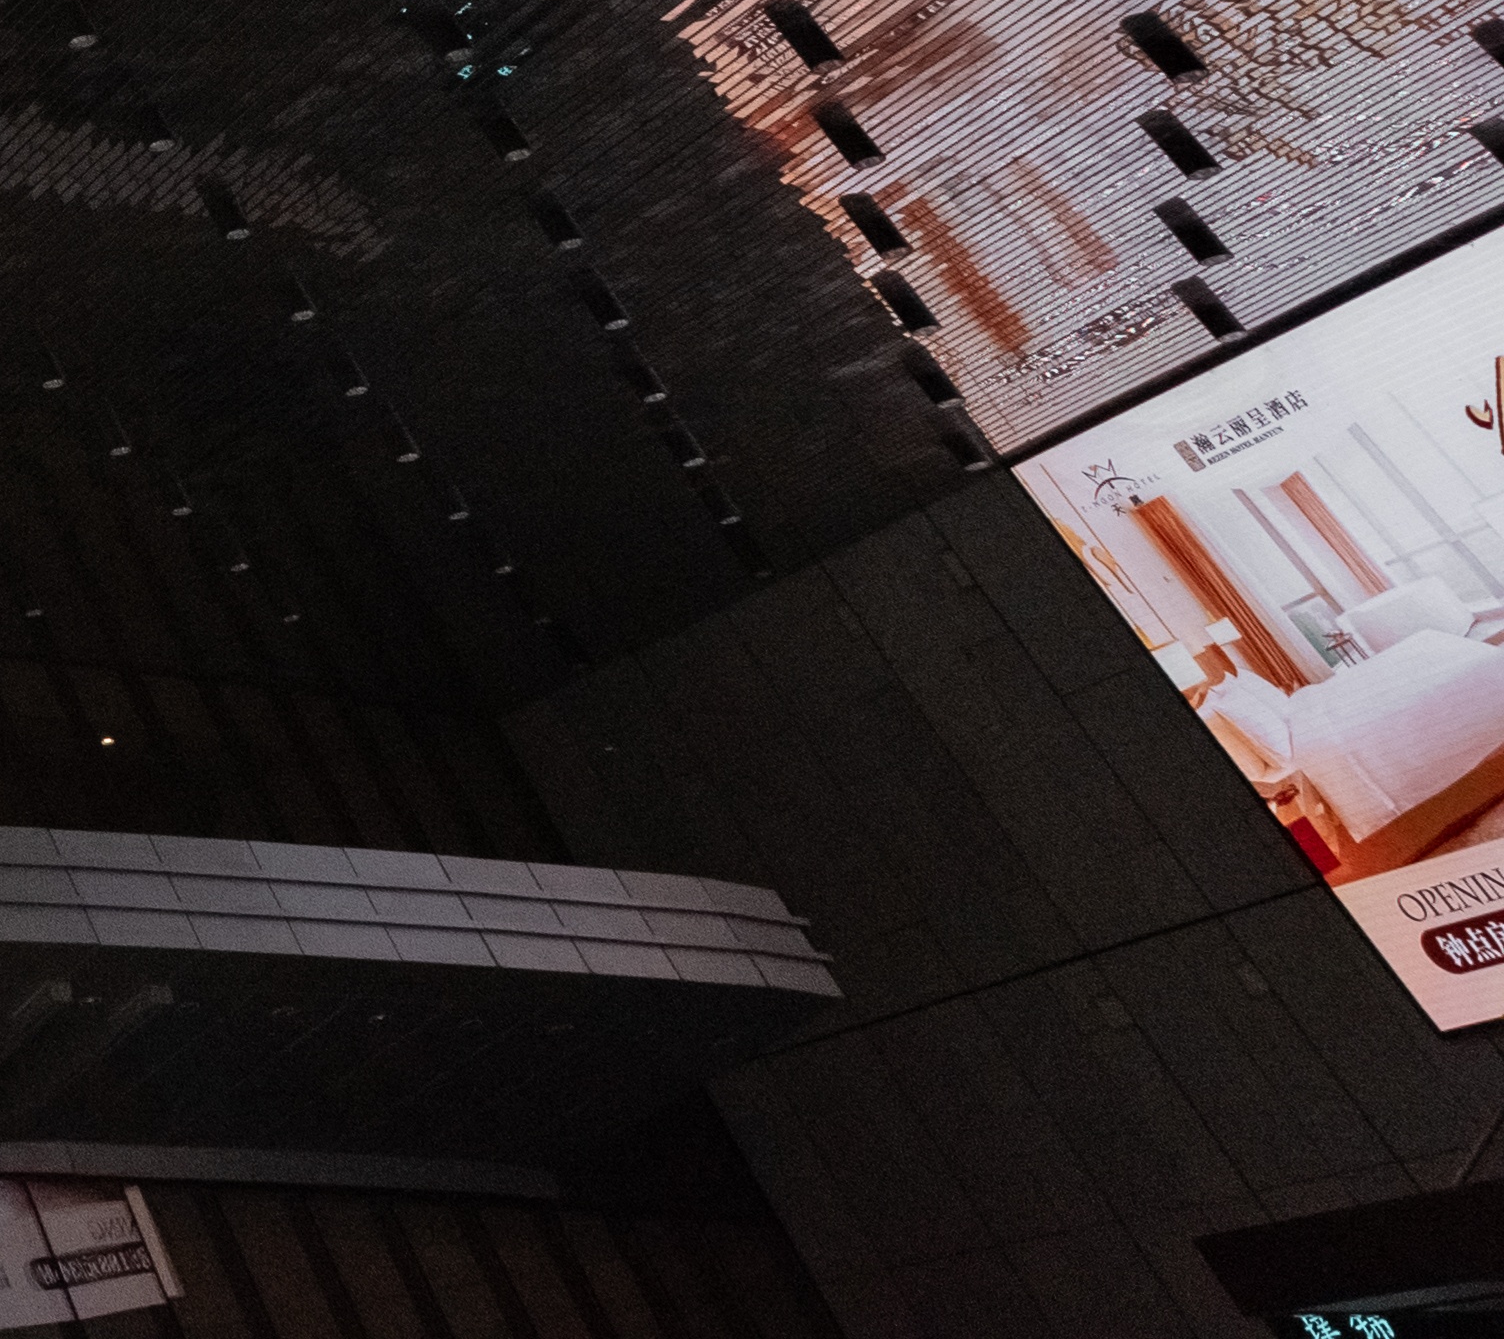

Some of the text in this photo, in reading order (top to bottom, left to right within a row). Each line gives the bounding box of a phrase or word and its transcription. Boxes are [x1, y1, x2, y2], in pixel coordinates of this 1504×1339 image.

[1190, 389, 1309, 454] 瀚云丽呈酒店
[1230, 437, 1254, 456] HOTEL
